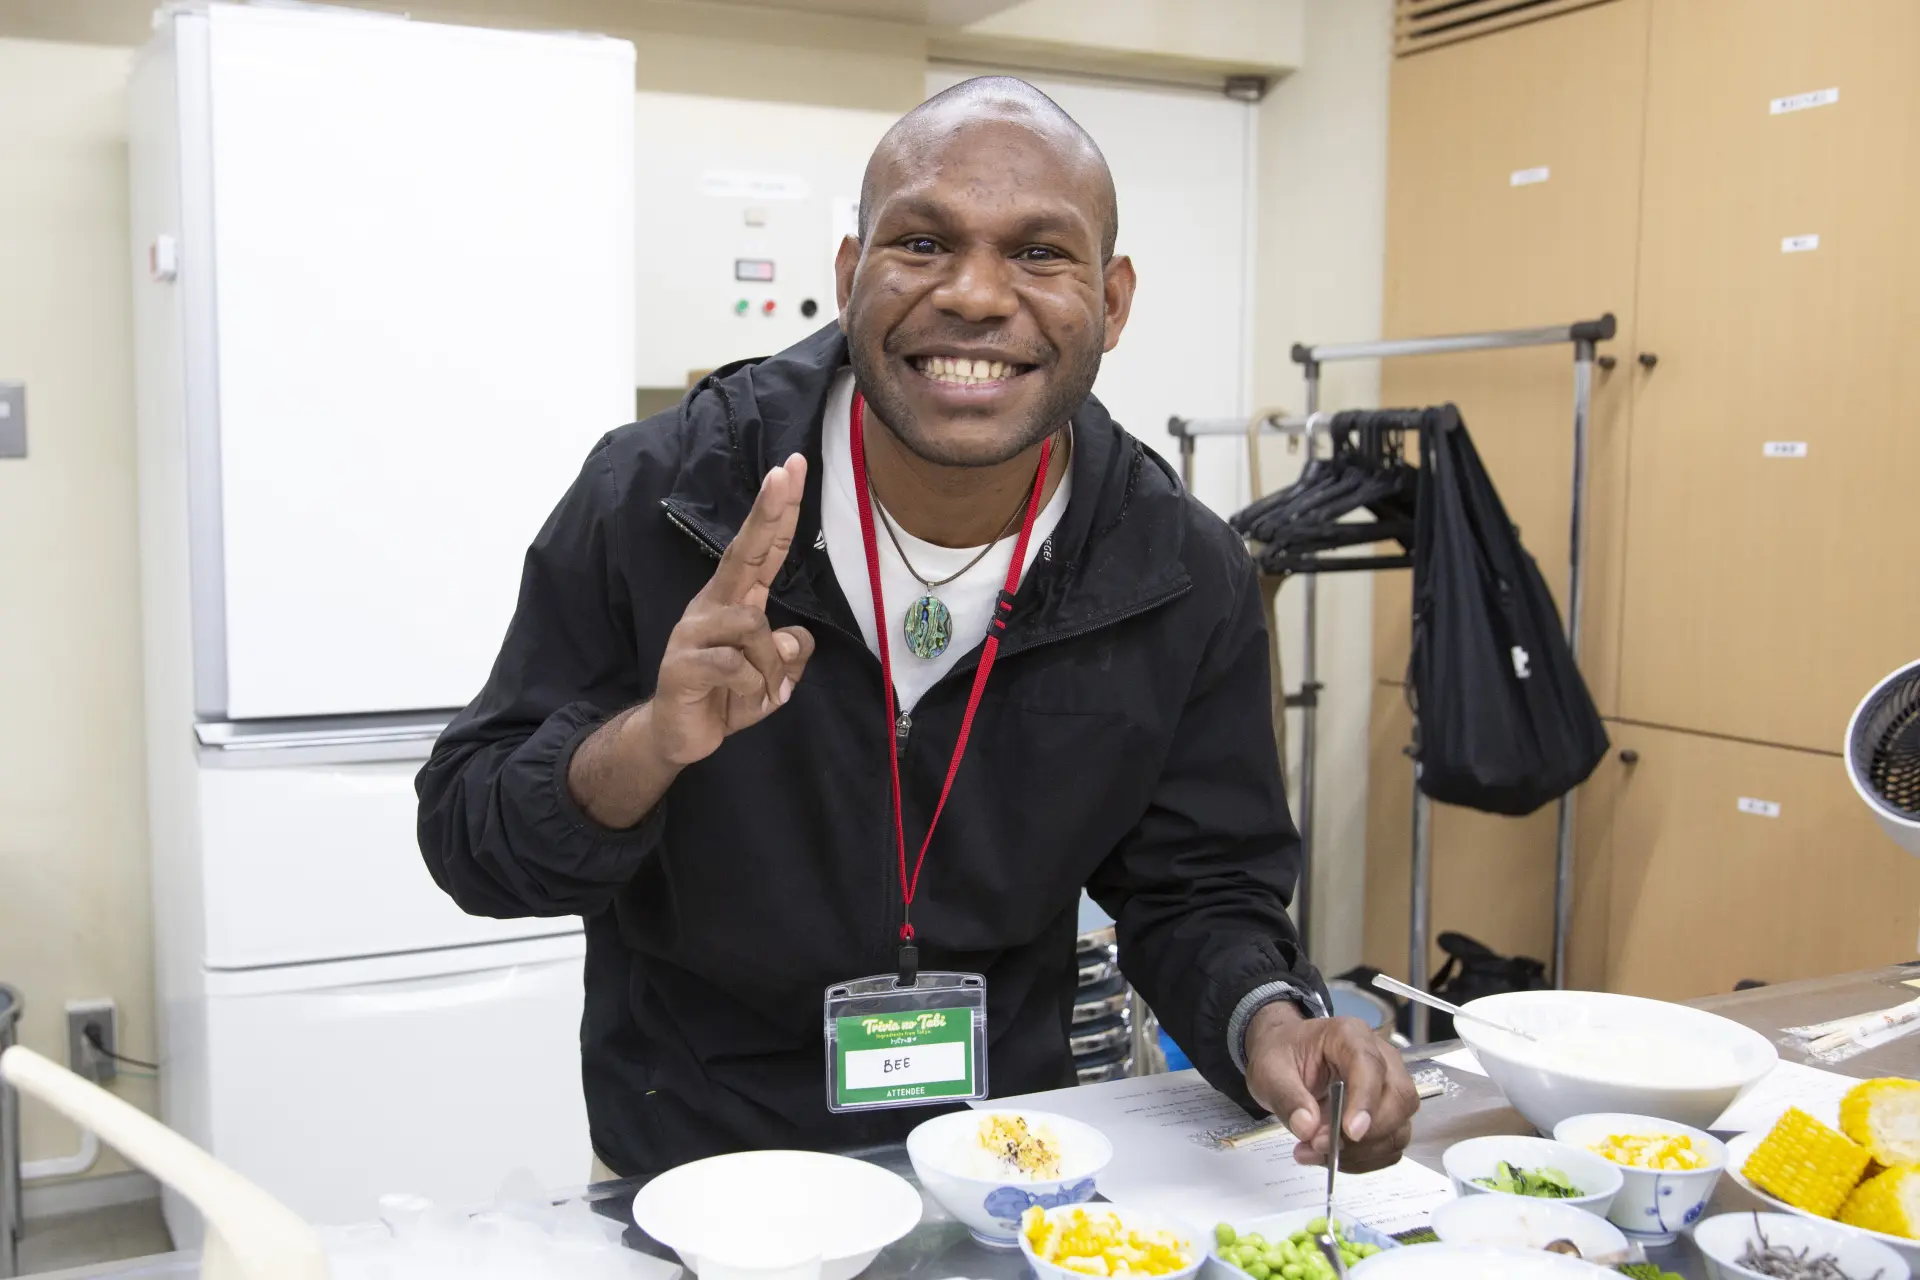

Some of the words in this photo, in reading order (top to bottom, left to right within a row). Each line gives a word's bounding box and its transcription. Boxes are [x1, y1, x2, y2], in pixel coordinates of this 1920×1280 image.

[862, 1018, 900, 1035] Trivia
[901, 1020, 918, 1030] no
[917, 1013, 947, 1029] Tabi
[884, 1058, 911, 1073] BEE
[887, 1087, 925, 1097] ATTENDEE
